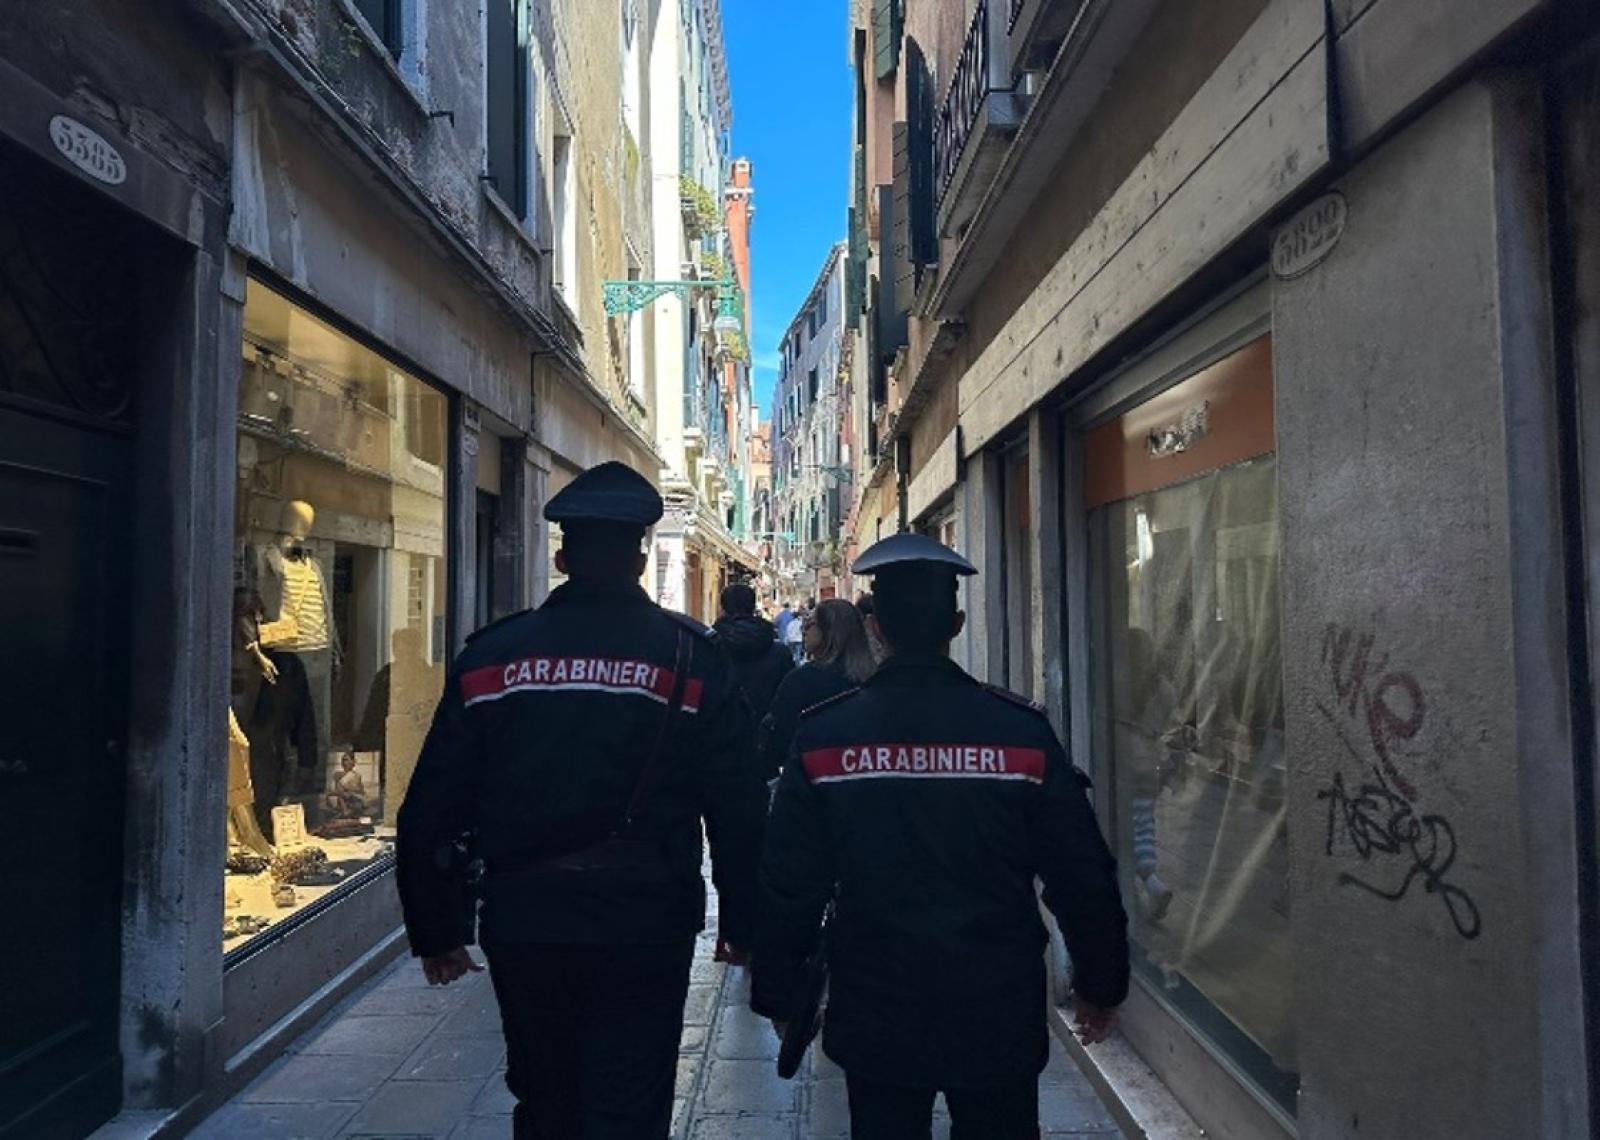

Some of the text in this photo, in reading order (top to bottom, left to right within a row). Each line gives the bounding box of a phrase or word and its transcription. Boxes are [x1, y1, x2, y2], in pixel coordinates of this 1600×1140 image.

[58, 120, 121, 180] 5385
[502, 658, 660, 690] CARABINIERI
[840, 747, 1007, 773] CARABINIERI
